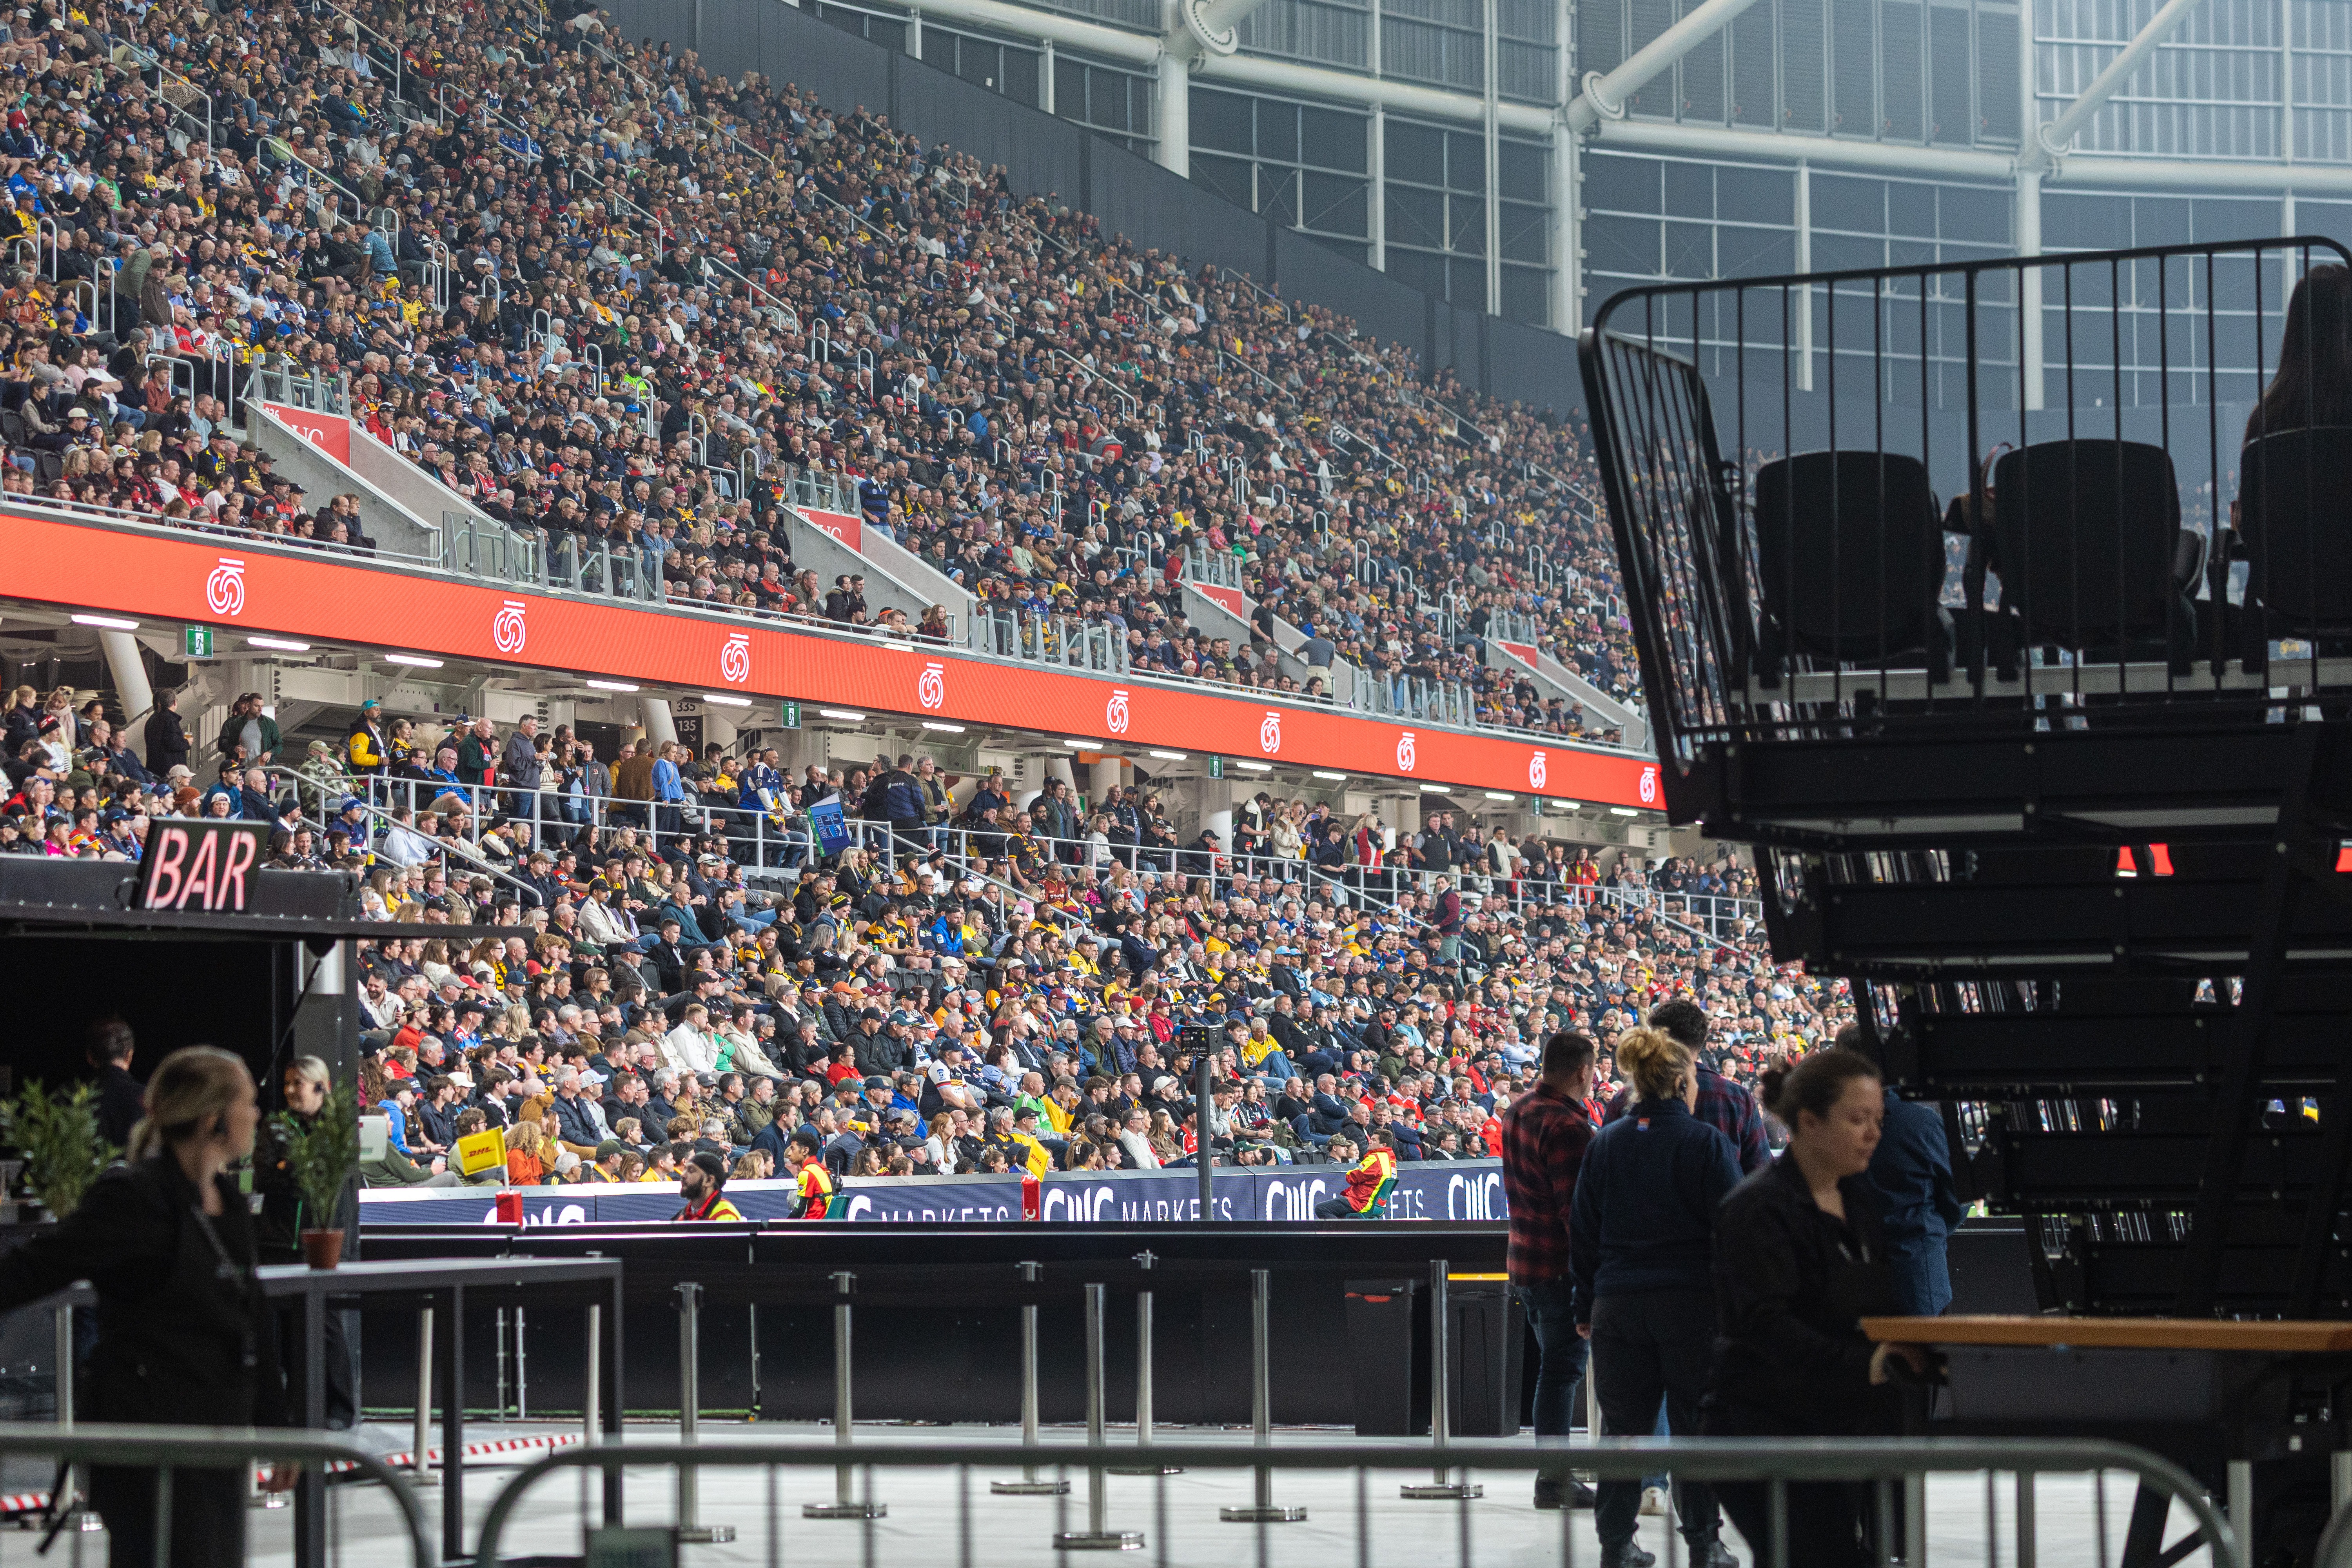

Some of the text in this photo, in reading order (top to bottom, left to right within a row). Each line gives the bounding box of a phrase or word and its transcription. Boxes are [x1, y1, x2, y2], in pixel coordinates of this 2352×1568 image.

[677, 702, 695, 712] 335
[678, 720, 696, 732] 135
[815, 817, 828, 838] BLUES
[144, 828, 257, 910] BAR
[468, 1147, 491, 1157] DHL
[1031, 1153, 1042, 1167] DHL
